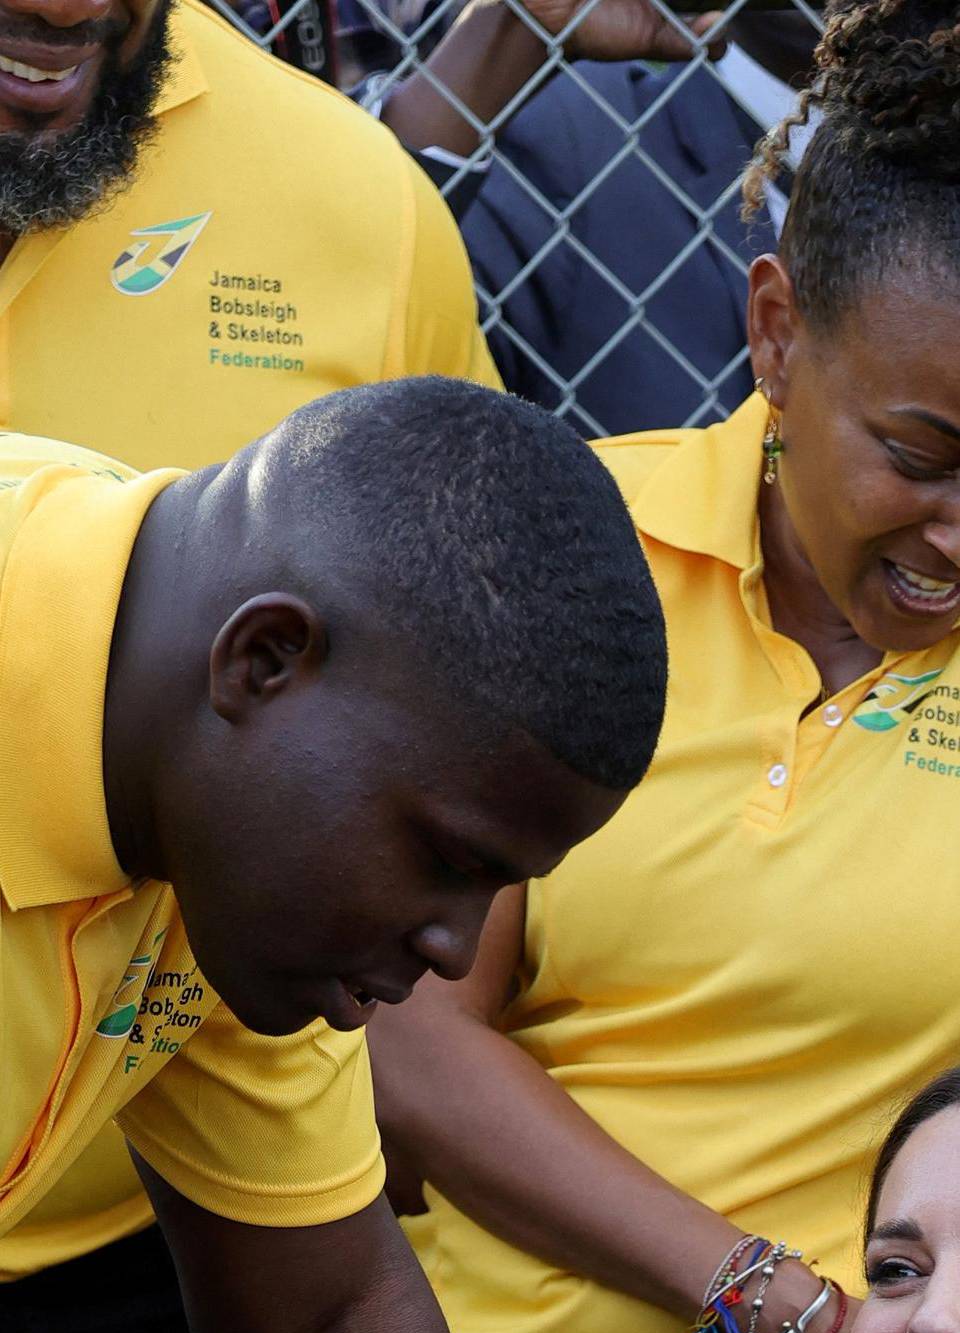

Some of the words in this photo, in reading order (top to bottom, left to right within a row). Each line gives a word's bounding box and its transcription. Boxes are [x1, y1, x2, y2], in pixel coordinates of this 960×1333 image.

[208, 270, 282, 293] Jamaica
[209, 295, 297, 323] Bobsleigh
[208, 320, 221, 339] &
[226, 322, 303, 346] Skeleton
[209, 348, 304, 372] Federation
[908, 727, 920, 743] &
[129, 1023, 144, 1045] &
